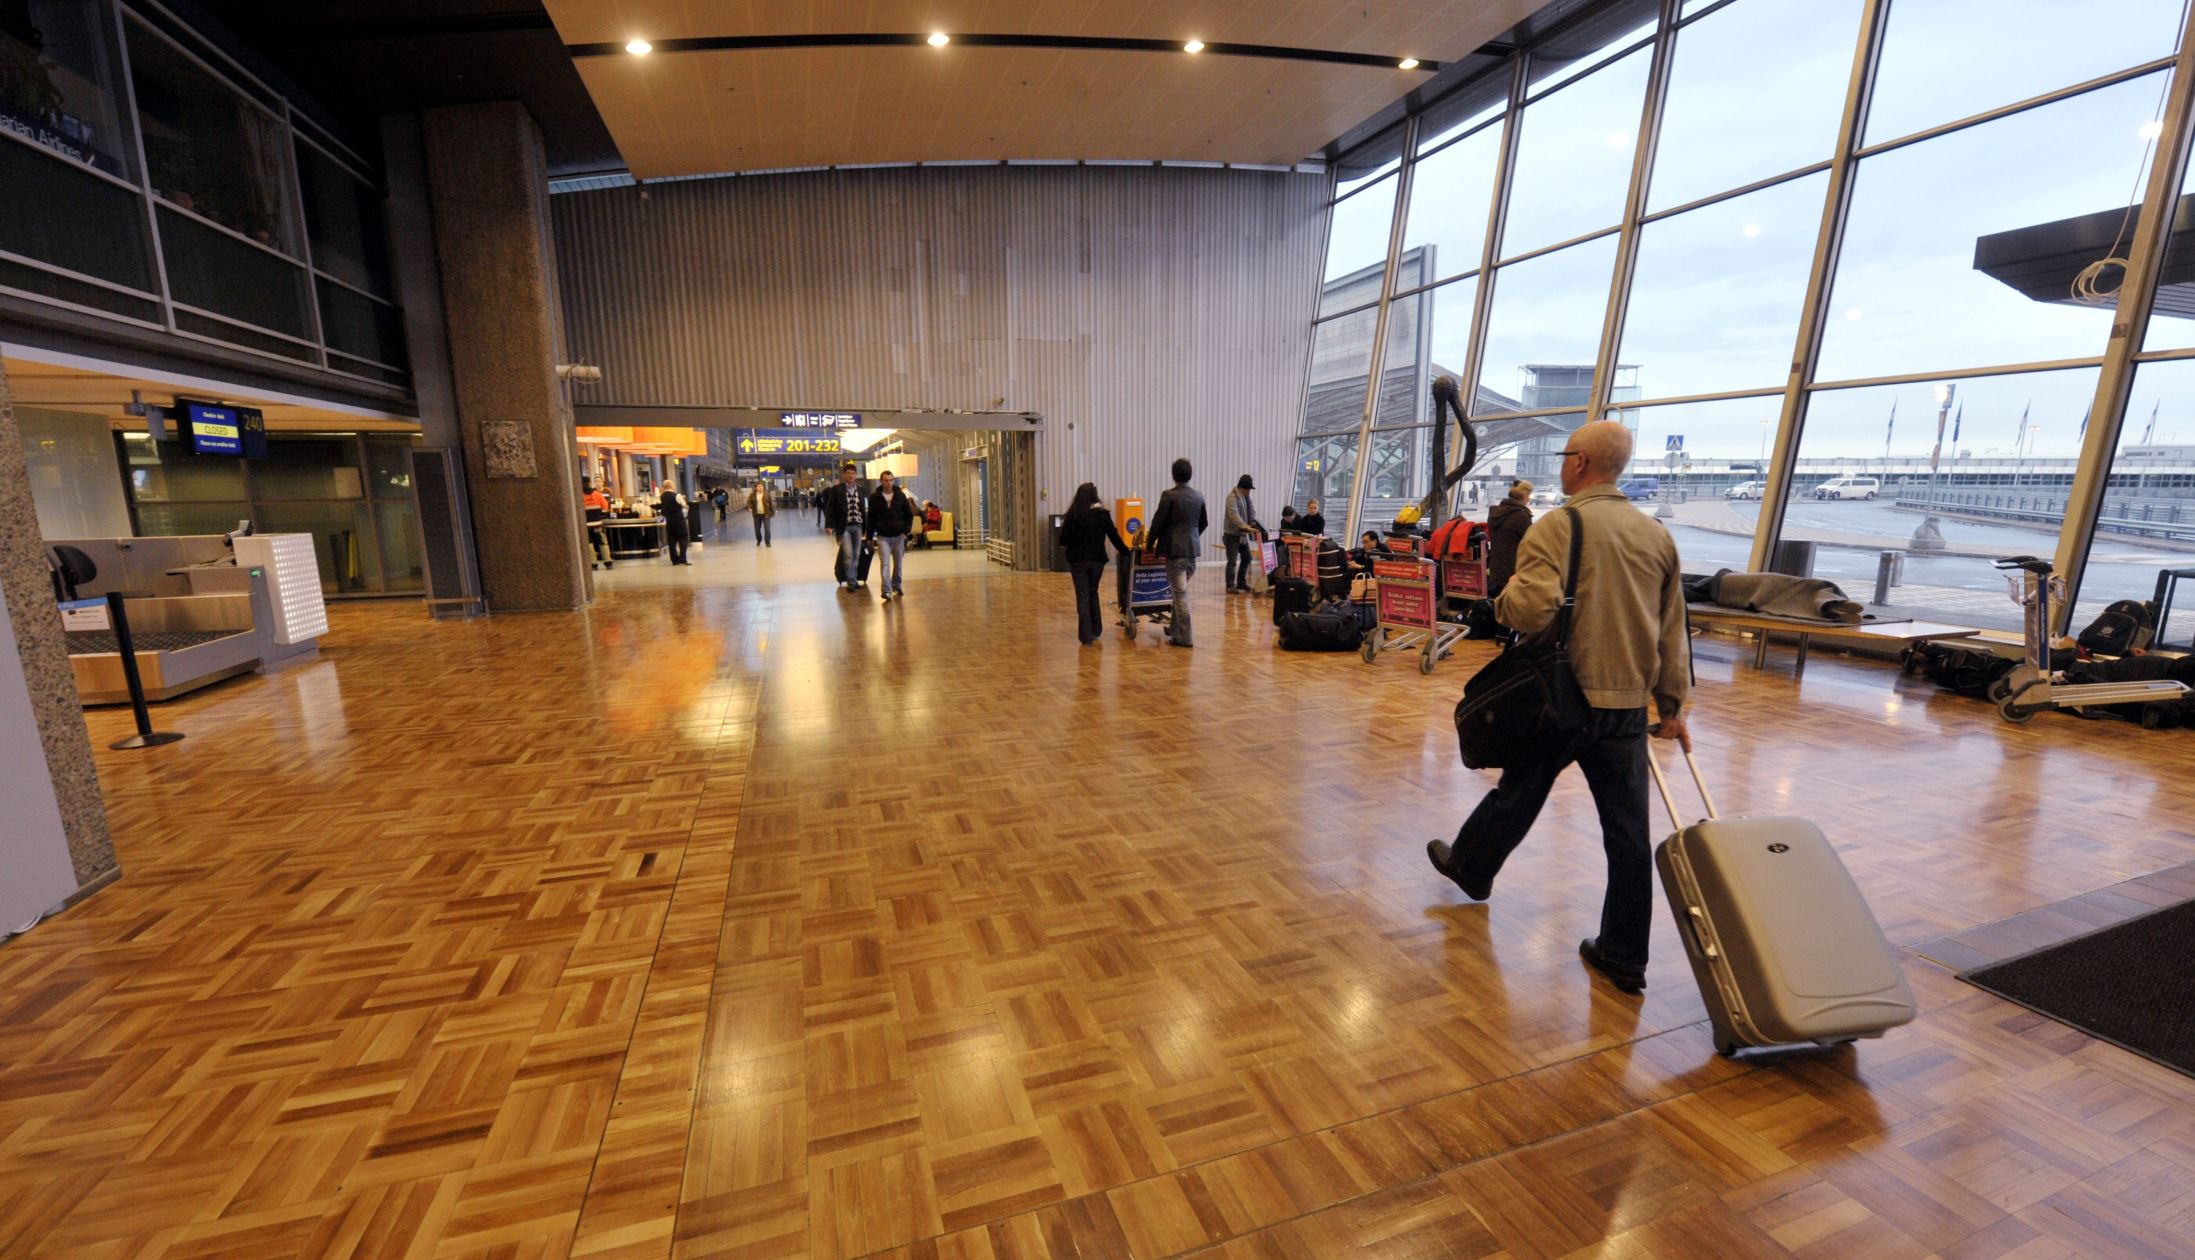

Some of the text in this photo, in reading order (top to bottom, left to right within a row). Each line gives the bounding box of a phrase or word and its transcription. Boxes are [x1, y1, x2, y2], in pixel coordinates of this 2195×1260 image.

[242, 414, 263, 432] 240
[204, 425, 229, 436] CLOSED
[786, 440, 839, 452] 201-232
